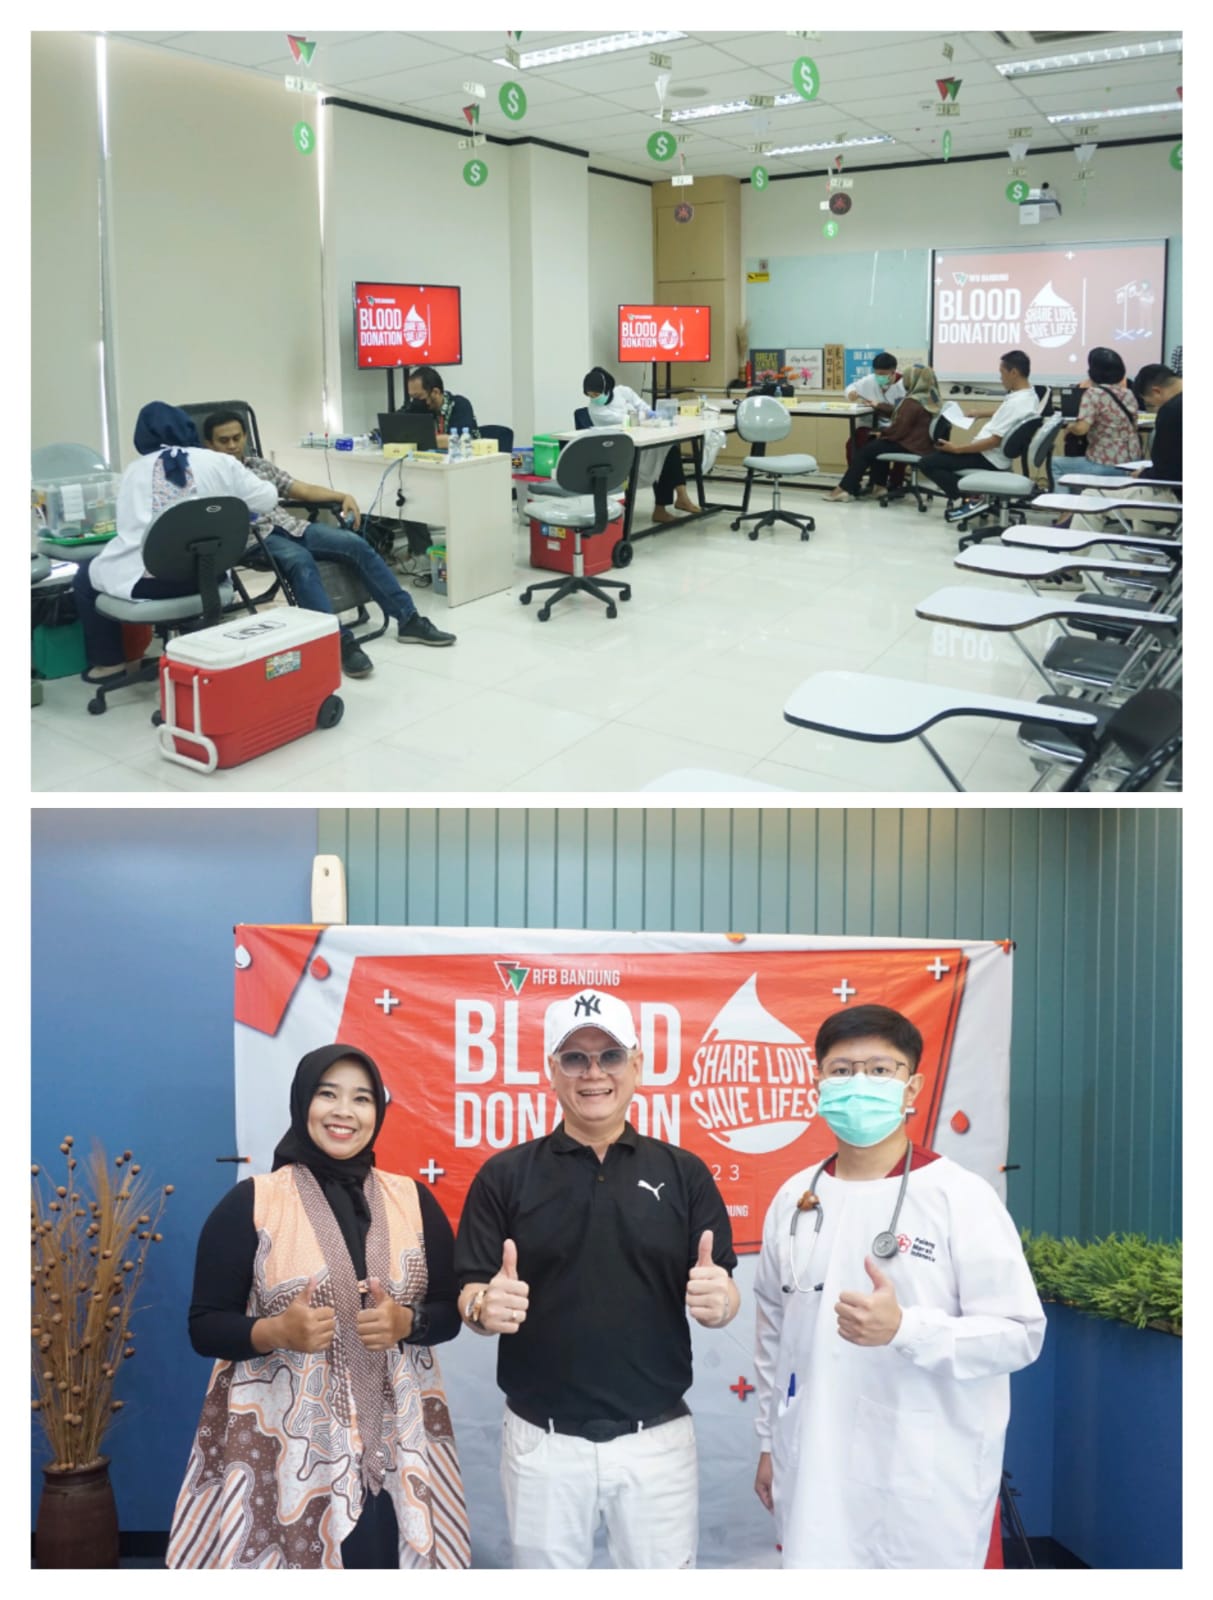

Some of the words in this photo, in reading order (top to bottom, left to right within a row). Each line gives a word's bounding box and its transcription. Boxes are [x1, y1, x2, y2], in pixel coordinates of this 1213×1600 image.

[938, 288, 1021, 321] BLOOD
[359, 308, 402, 331] BLOOD
[621, 321, 657, 338] BLOOD
[938, 322, 1021, 345] DONATION
[360, 331, 403, 347] DONATION
[532, 968, 557, 985] RFB
[560, 969, 621, 987] BANDUNG
[455, 999, 682, 1087] BLD
[688, 1044, 761, 1087] SHARE
[455, 1091, 681, 1149] DONON
[689, 1086, 753, 1130] SAVE
[756, 1087, 819, 1121] LIFES
